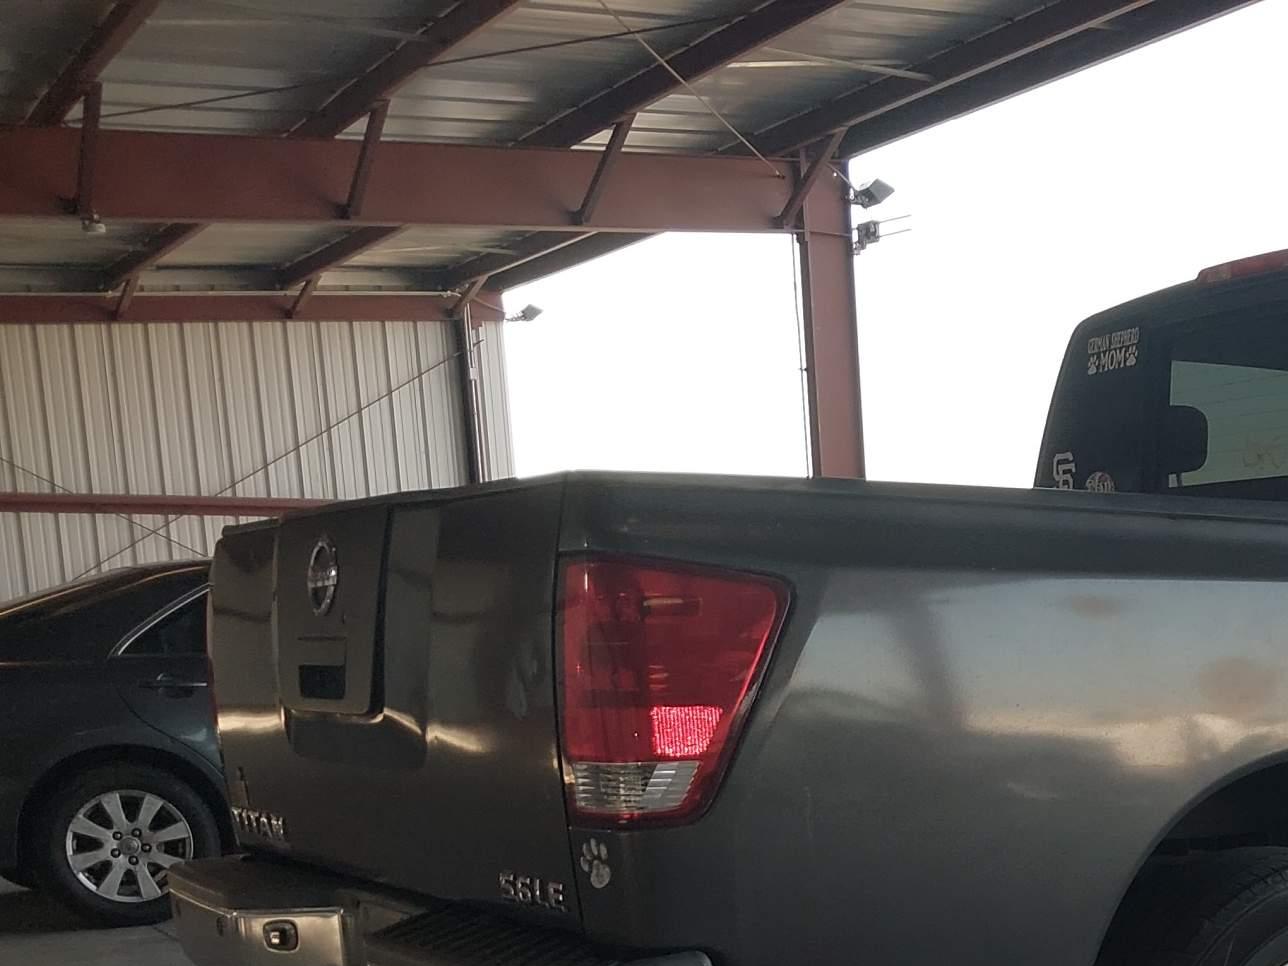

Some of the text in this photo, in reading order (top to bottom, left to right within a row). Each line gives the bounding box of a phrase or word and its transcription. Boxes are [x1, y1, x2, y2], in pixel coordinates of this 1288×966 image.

[1087, 327, 1139, 354] GERMAN SHEPHERD
[1099, 347, 1126, 374] MOM
